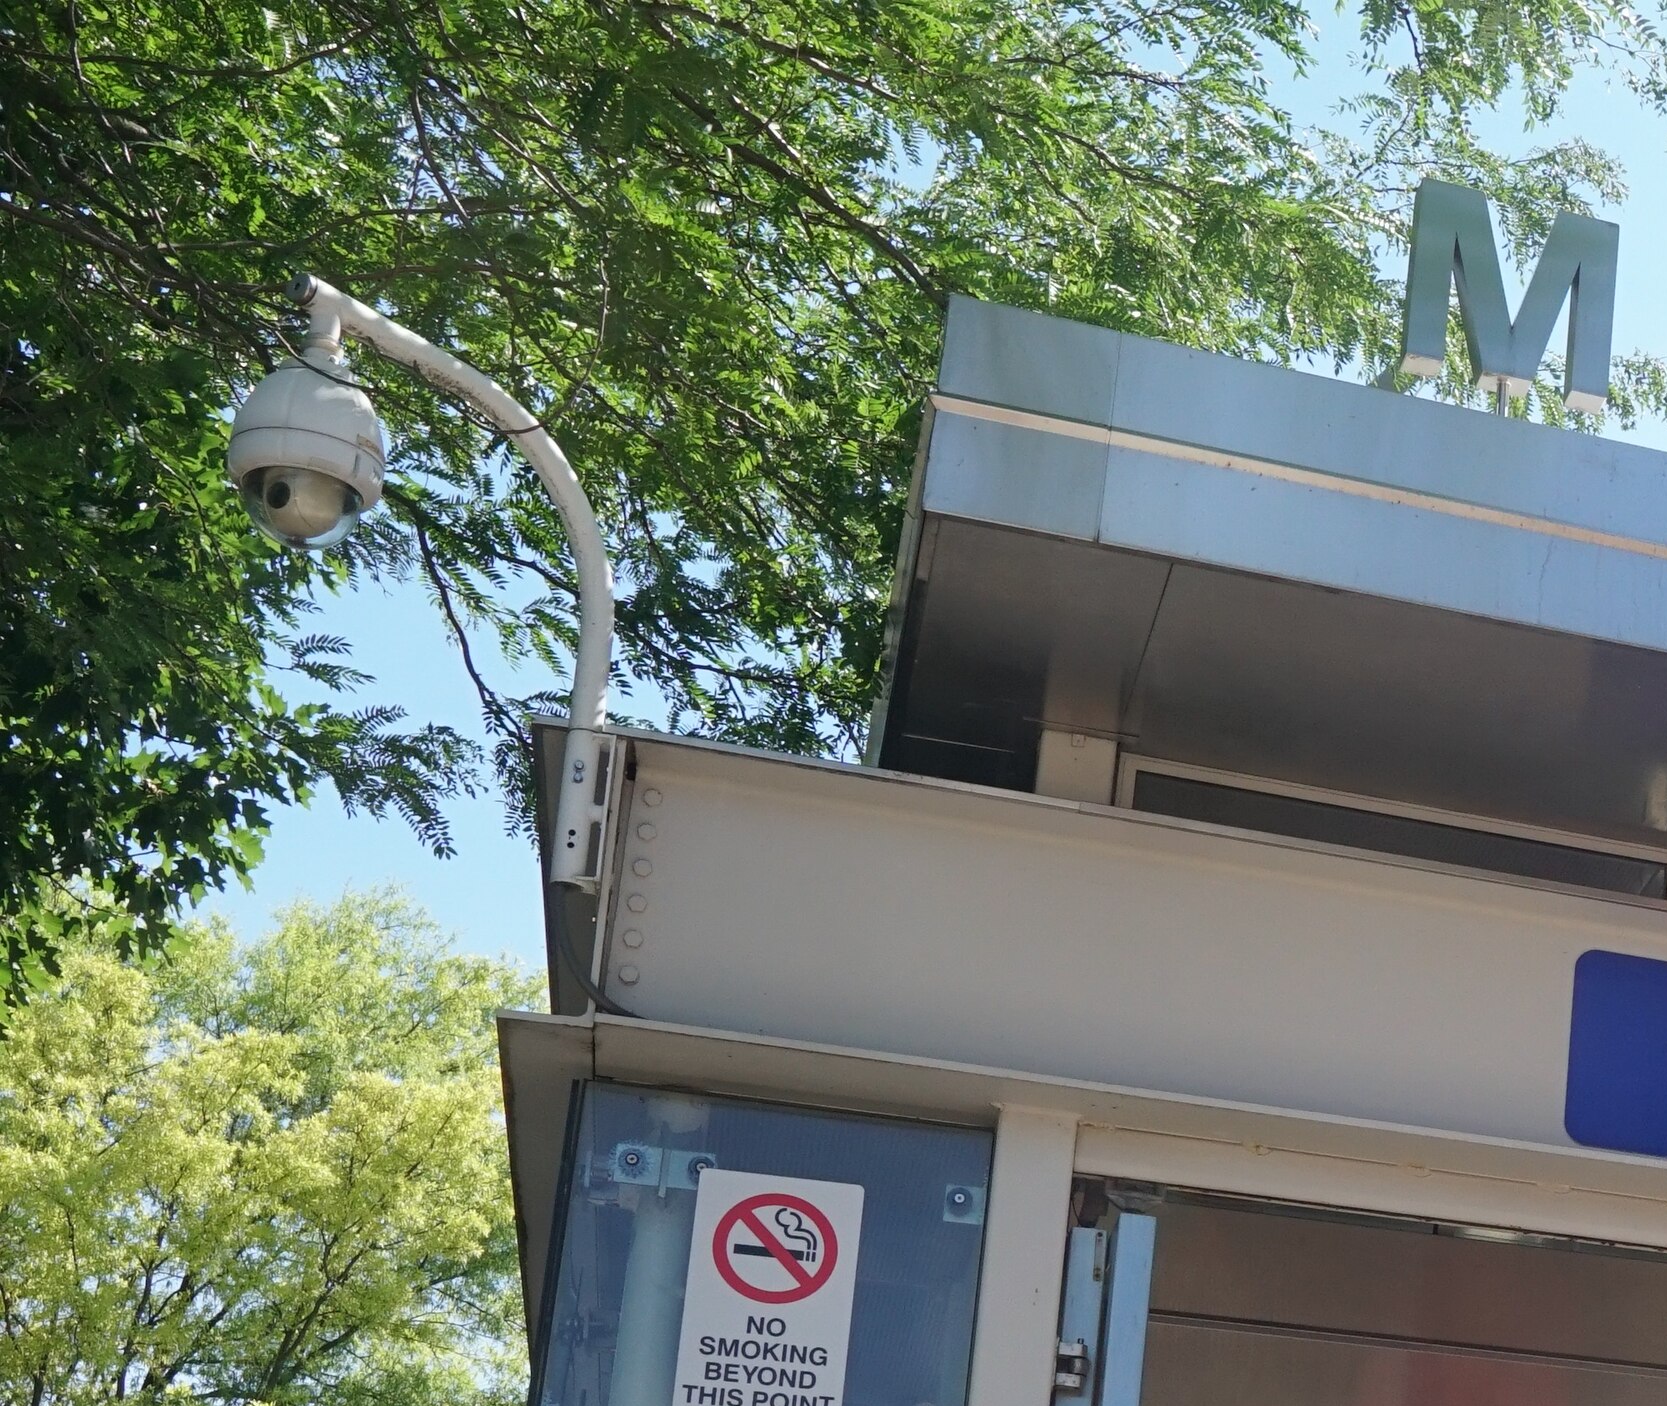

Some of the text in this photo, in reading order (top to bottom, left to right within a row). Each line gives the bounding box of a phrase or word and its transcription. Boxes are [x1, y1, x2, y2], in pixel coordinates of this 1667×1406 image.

[746, 1316, 786, 1337] NO
[699, 1336, 827, 1366] SMOKING
[704, 1362, 816, 1389] BEYOND
